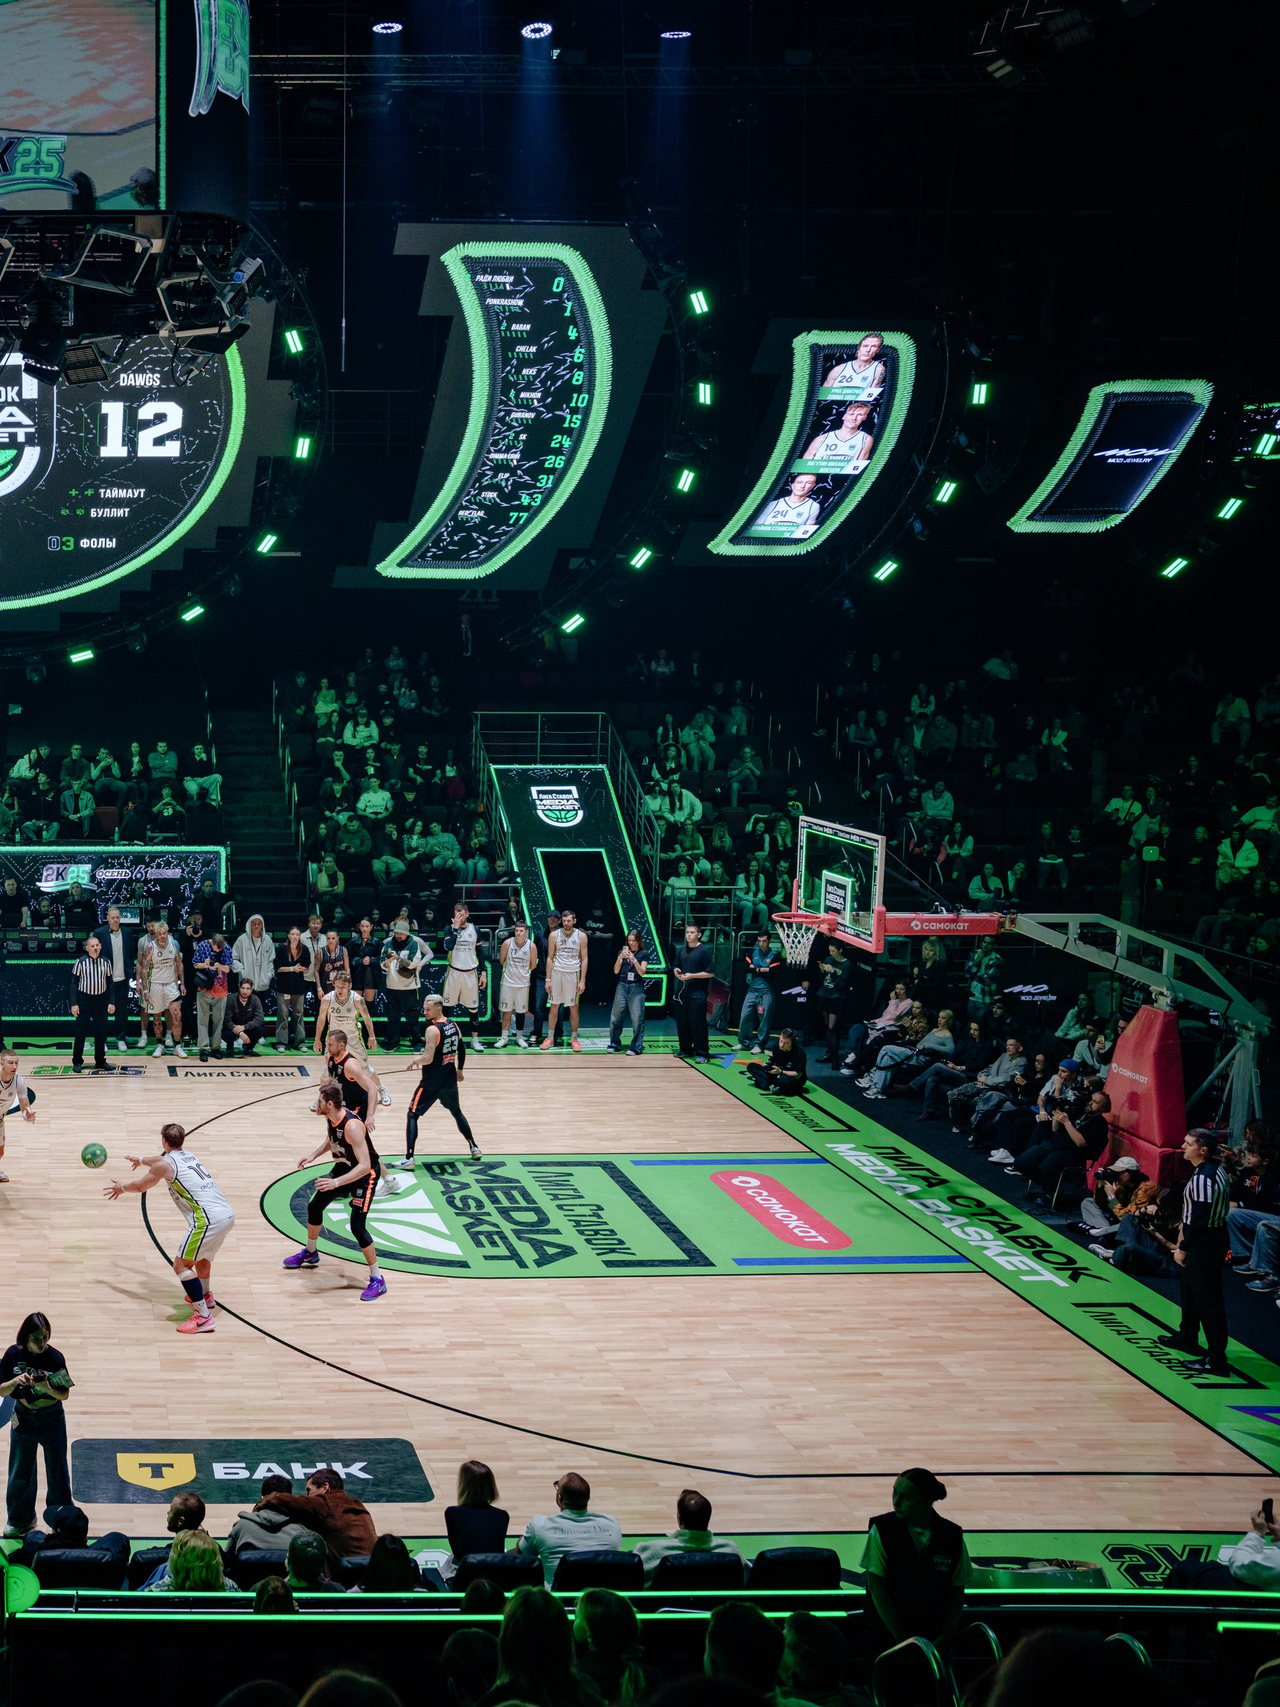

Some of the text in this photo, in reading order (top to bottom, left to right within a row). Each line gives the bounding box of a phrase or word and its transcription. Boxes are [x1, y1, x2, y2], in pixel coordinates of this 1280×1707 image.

[552, 277, 565, 292] 0
[563, 301, 573, 316] 1
[500, 322, 507, 330] 2
[567, 325, 579, 340] 4
[573, 348, 586, 363] 6
[119, 373, 161, 387] DAWGS
[571, 371, 584, 385] 8
[837, 375, 853, 384] 26
[569, 393, 589, 408] 10
[562, 414, 582, 428] 15
[99, 401, 184, 459] 12
[550, 435, 572, 448] 24
[824, 443, 838, 452] 10
[544, 455, 566, 468] 26
[536, 475, 554, 487] 31
[99, 487, 146, 499] ТАЙМАУТ
[521, 493, 542, 506] 43
[90, 506, 130, 519] БУЛЛИТ
[508, 512, 529, 525] 77
[771, 509, 789, 519] 24
[47, 535, 117, 551] 03 ФОЛЫ
[96, 869, 131, 879] ОСЕНЬ
[330, 1006, 342, 1014] 26
[443, 1035, 459, 1051] 23
[421, 1161, 530, 1269] BASKET
[461, 1161, 579, 1268] MEDIA
[825, 1143, 1070, 1288] MEDIA BASKET
[863, 1144, 1112, 1285] ЛИГА СТАВОК
[212, 1462, 374, 1480] БАНК
